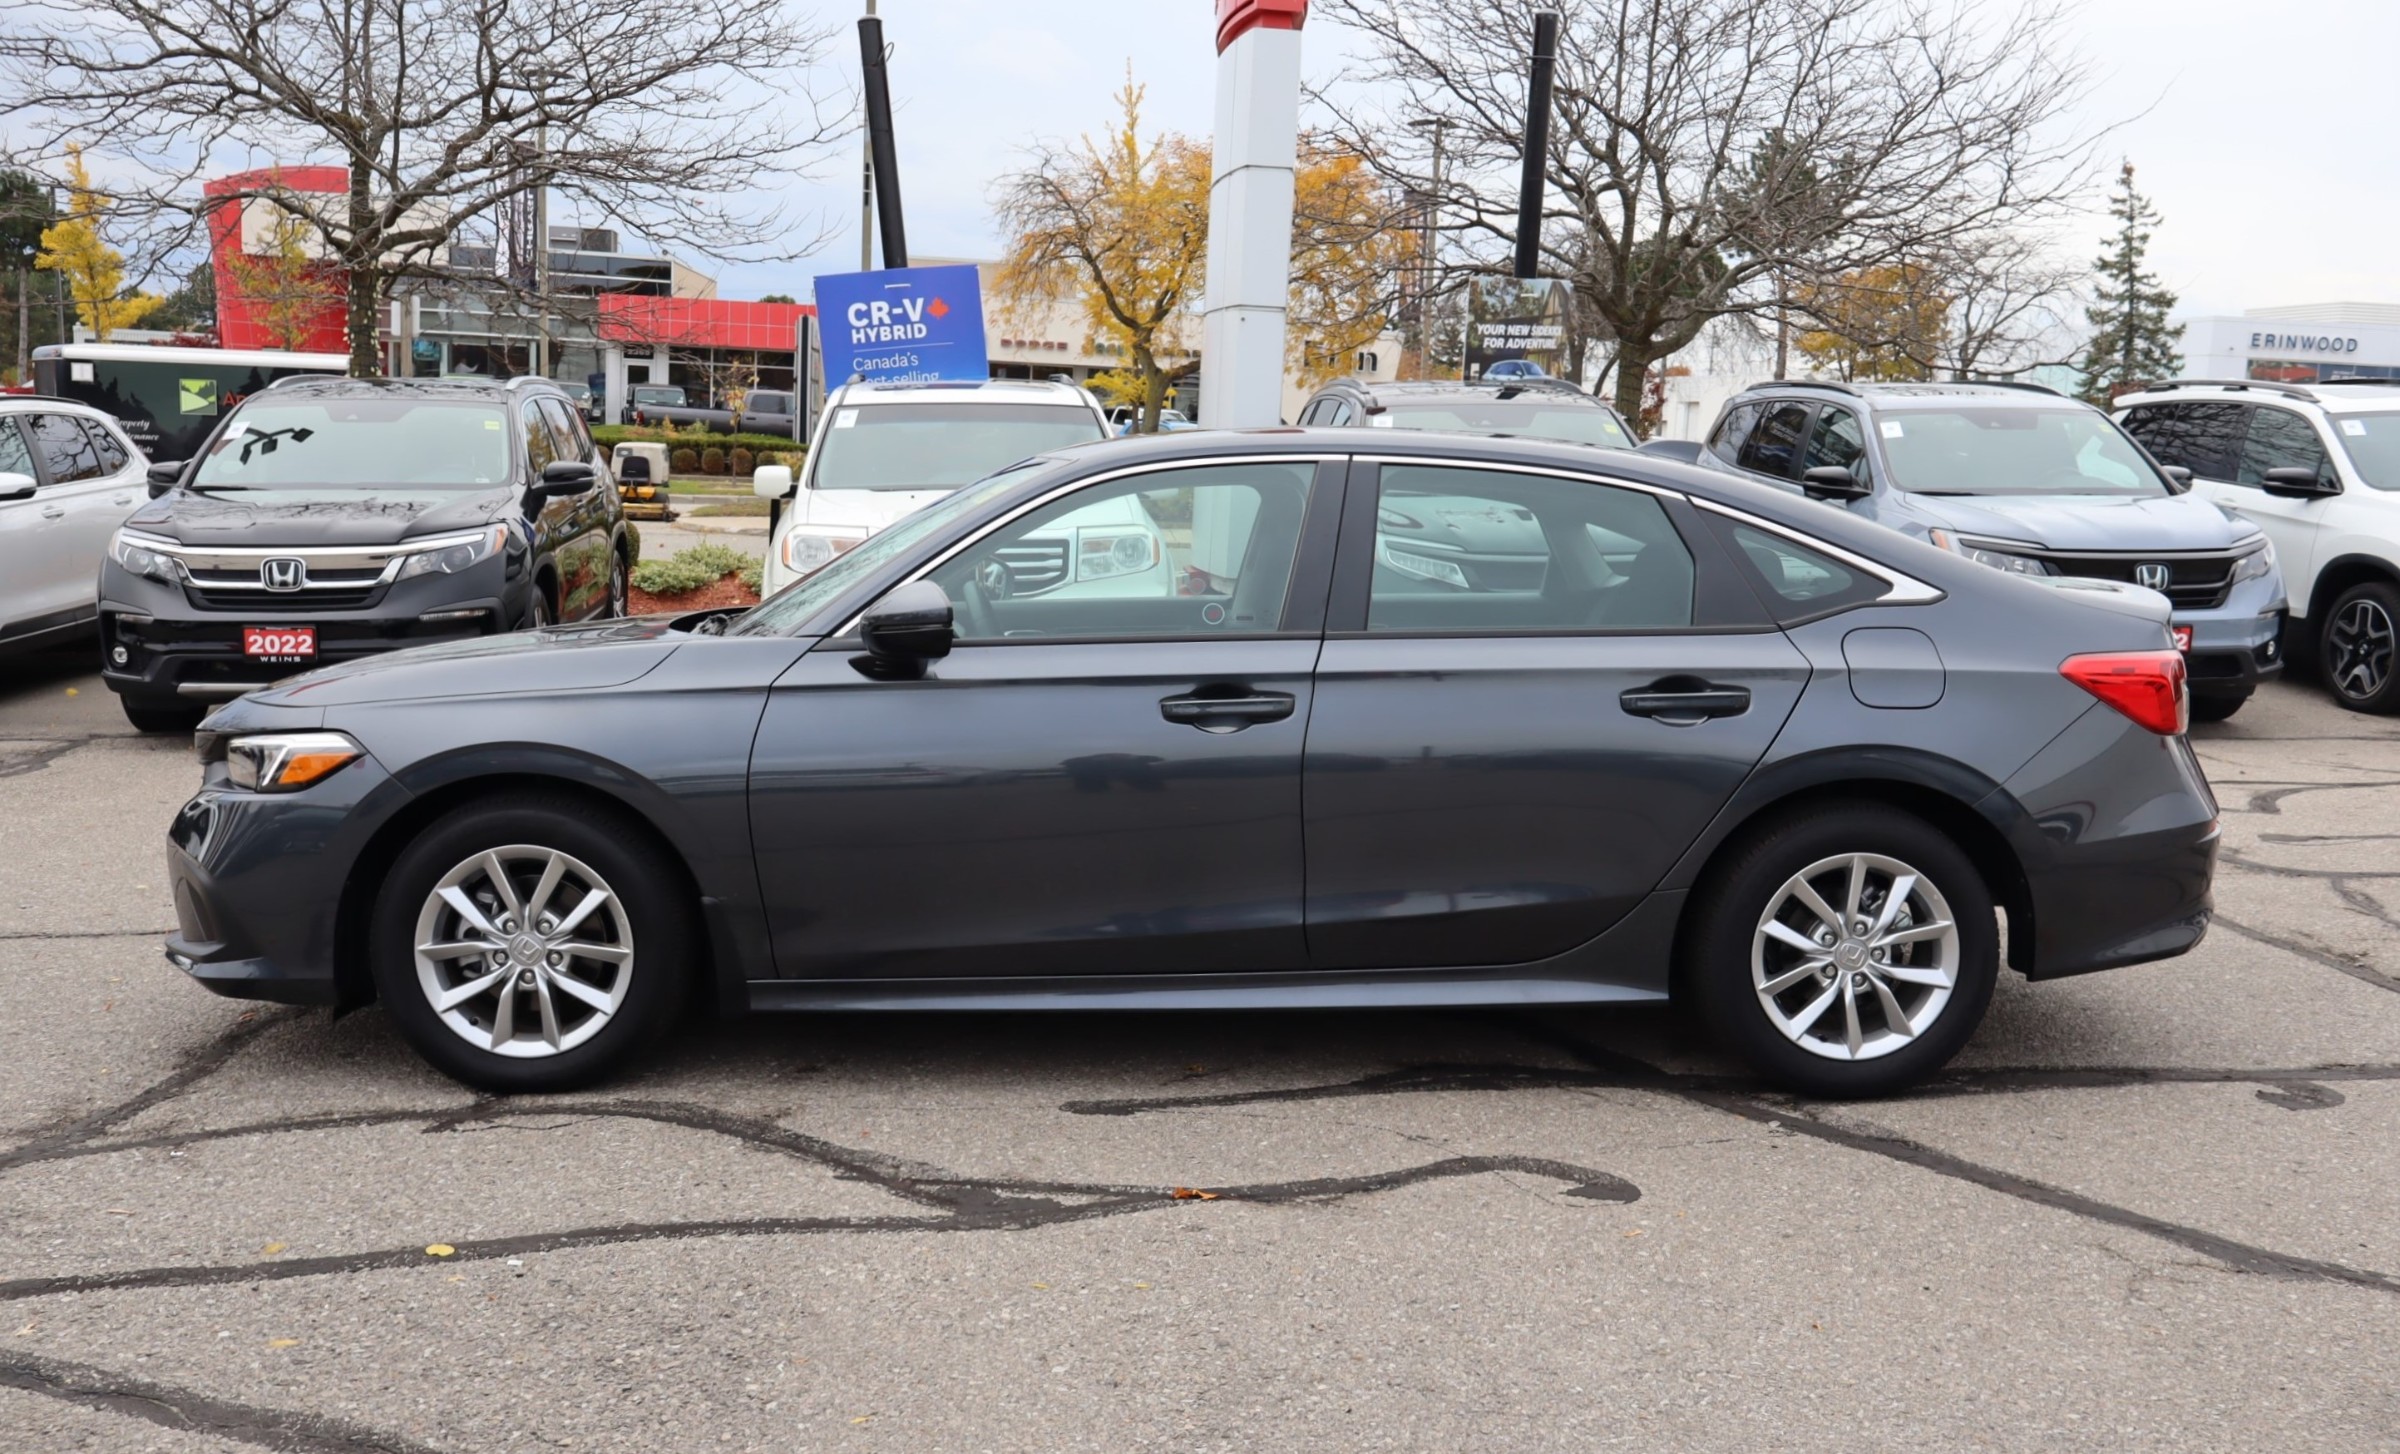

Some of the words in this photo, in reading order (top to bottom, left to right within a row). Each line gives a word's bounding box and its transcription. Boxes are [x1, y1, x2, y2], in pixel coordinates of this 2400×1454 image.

[847, 297, 925, 327] CR-V
[851, 323, 927, 344] HYBRID
[1476, 323, 1506, 336] YOUR
[1507, 324, 1530, 336] NEW
[1482, 338, 1504, 349] FOR
[2251, 333, 2358, 352] ERINWOOD
[853, 352, 919, 371] Canada's
[865, 370, 939, 384] est-selling
[118, 419, 151, 431] roperty
[248, 635, 313, 653] 2022
